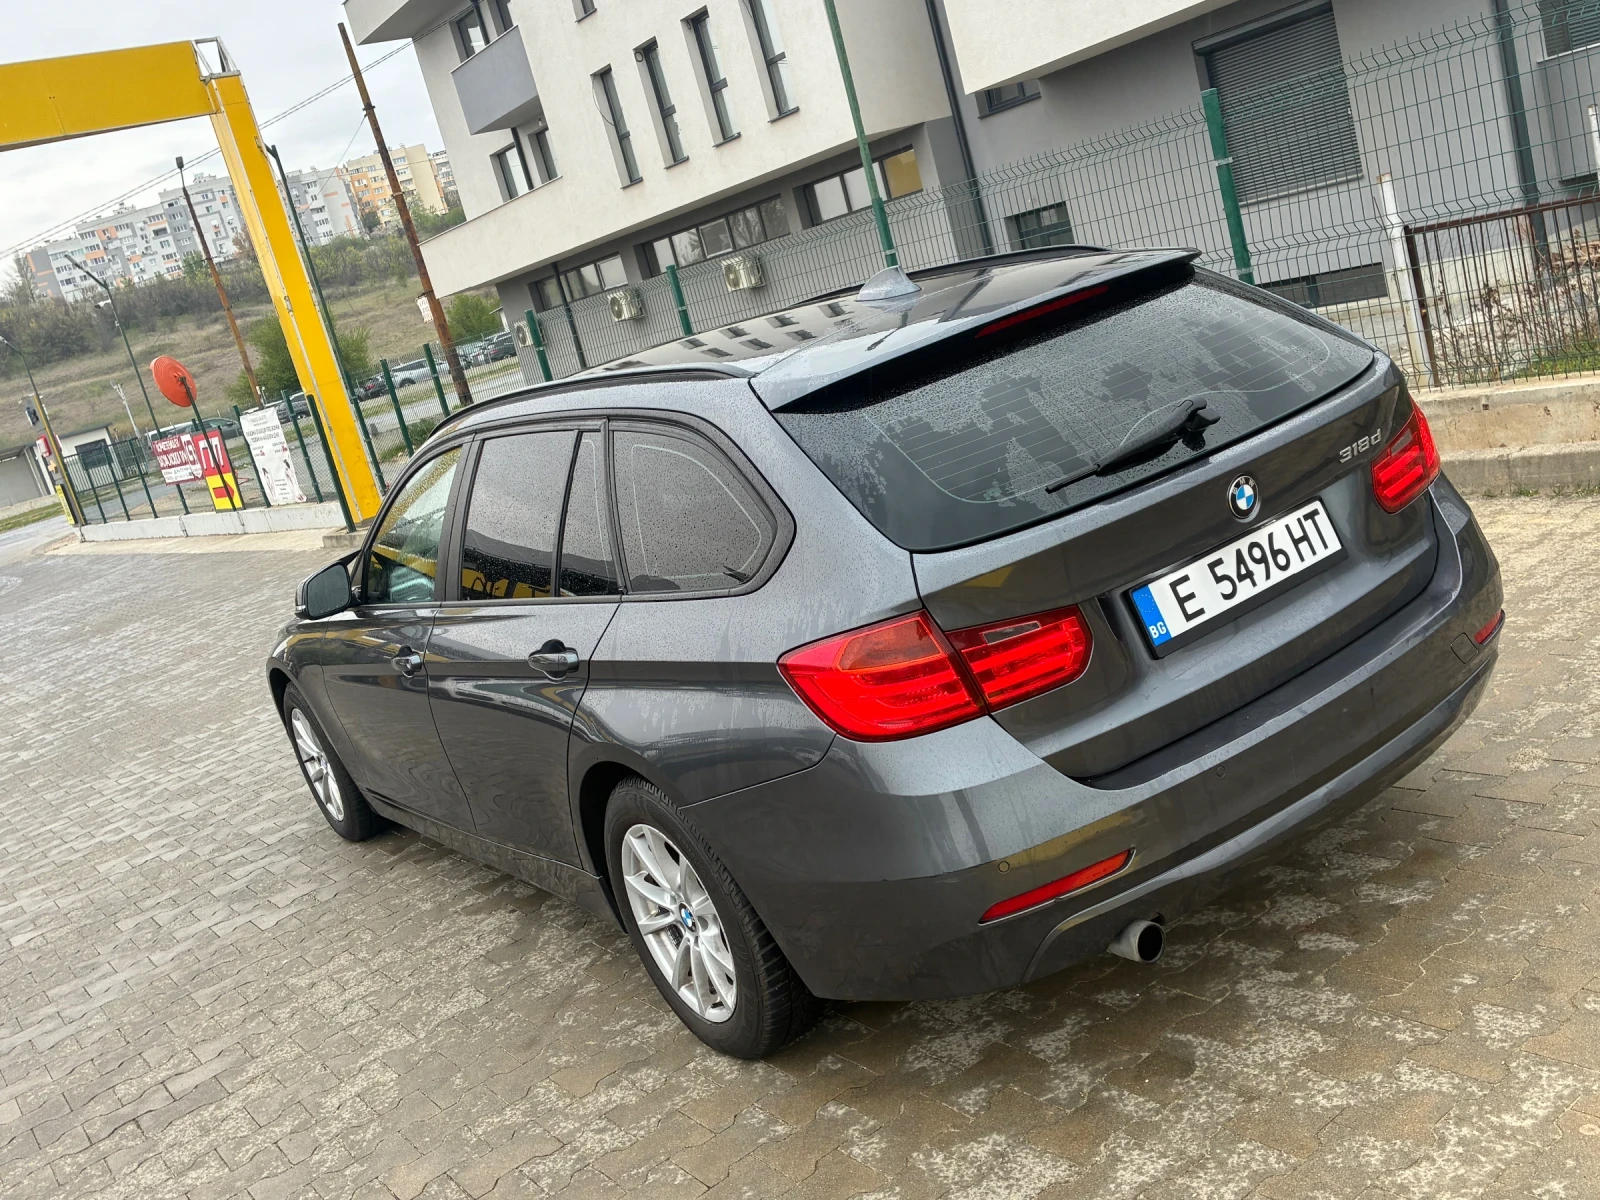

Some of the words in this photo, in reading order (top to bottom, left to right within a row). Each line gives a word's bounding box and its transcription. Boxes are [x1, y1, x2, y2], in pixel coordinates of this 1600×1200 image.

[1338, 428, 1383, 464] 318d
[1232, 477, 1256, 495] BMW
[1169, 575, 1205, 623] E
[1207, 532, 1291, 601] 5496
[1285, 508, 1330, 563] HT
[1149, 621, 1167, 640] BG
